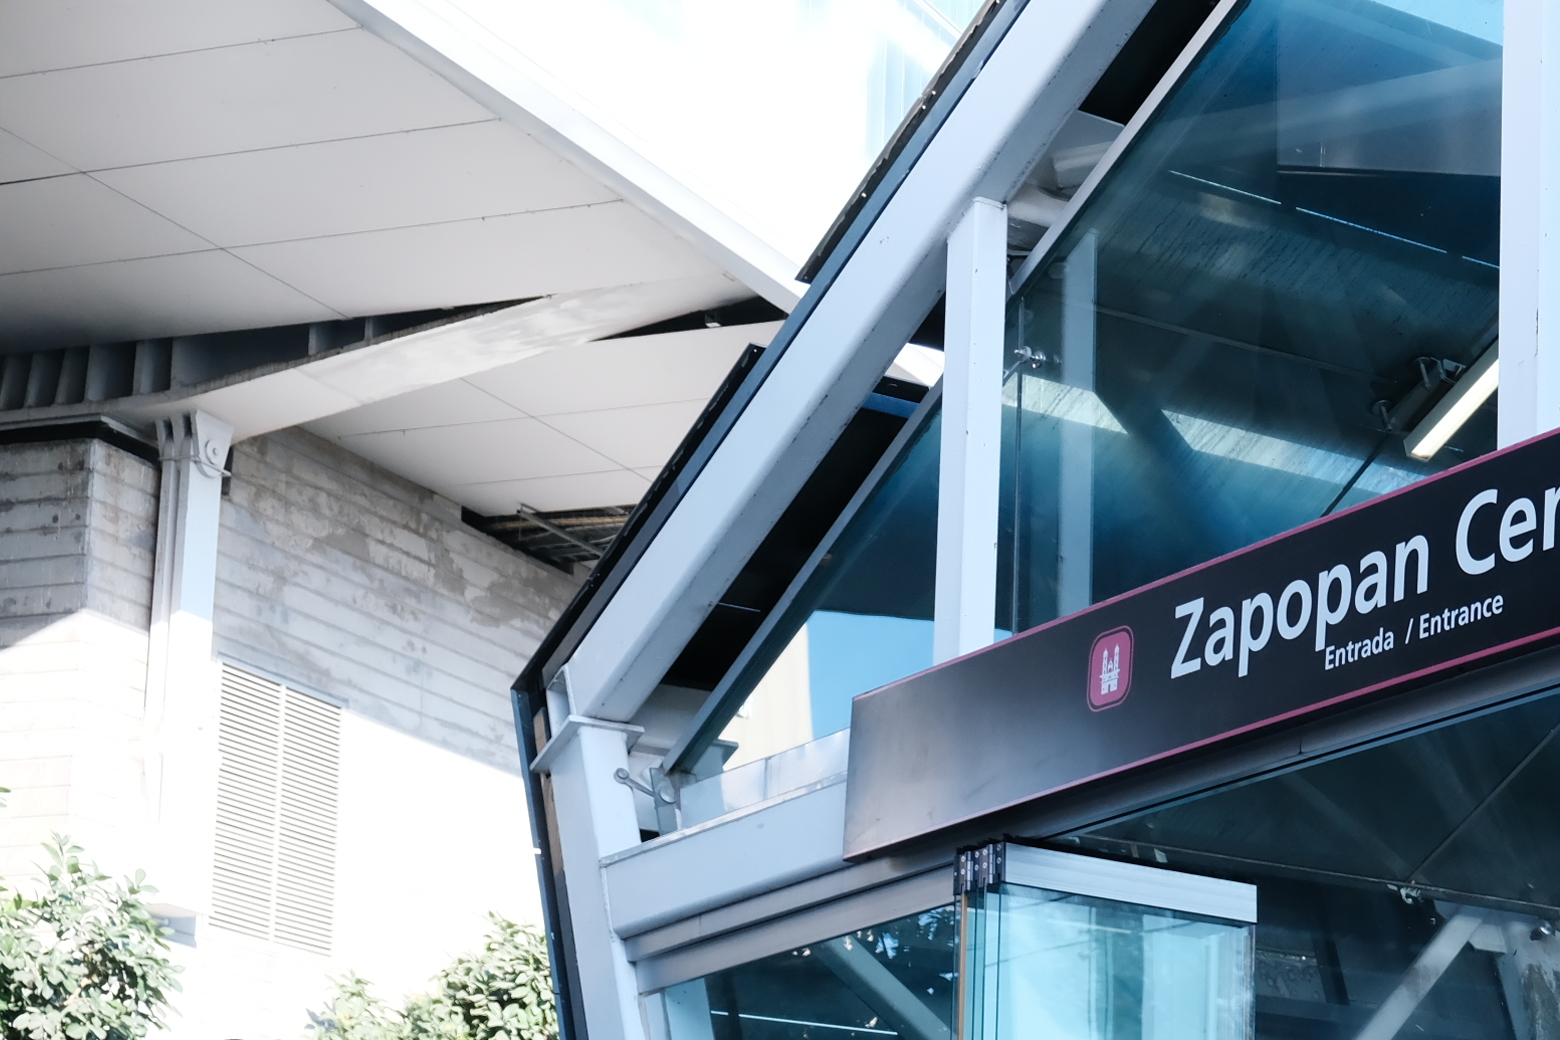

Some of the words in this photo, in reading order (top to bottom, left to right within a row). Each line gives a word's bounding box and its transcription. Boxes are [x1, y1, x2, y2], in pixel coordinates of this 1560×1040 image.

[1170, 534, 1430, 680] Zapopan
[1324, 627, 1395, 671] Entrada
[1418, 594, 1504, 640] Entrance
